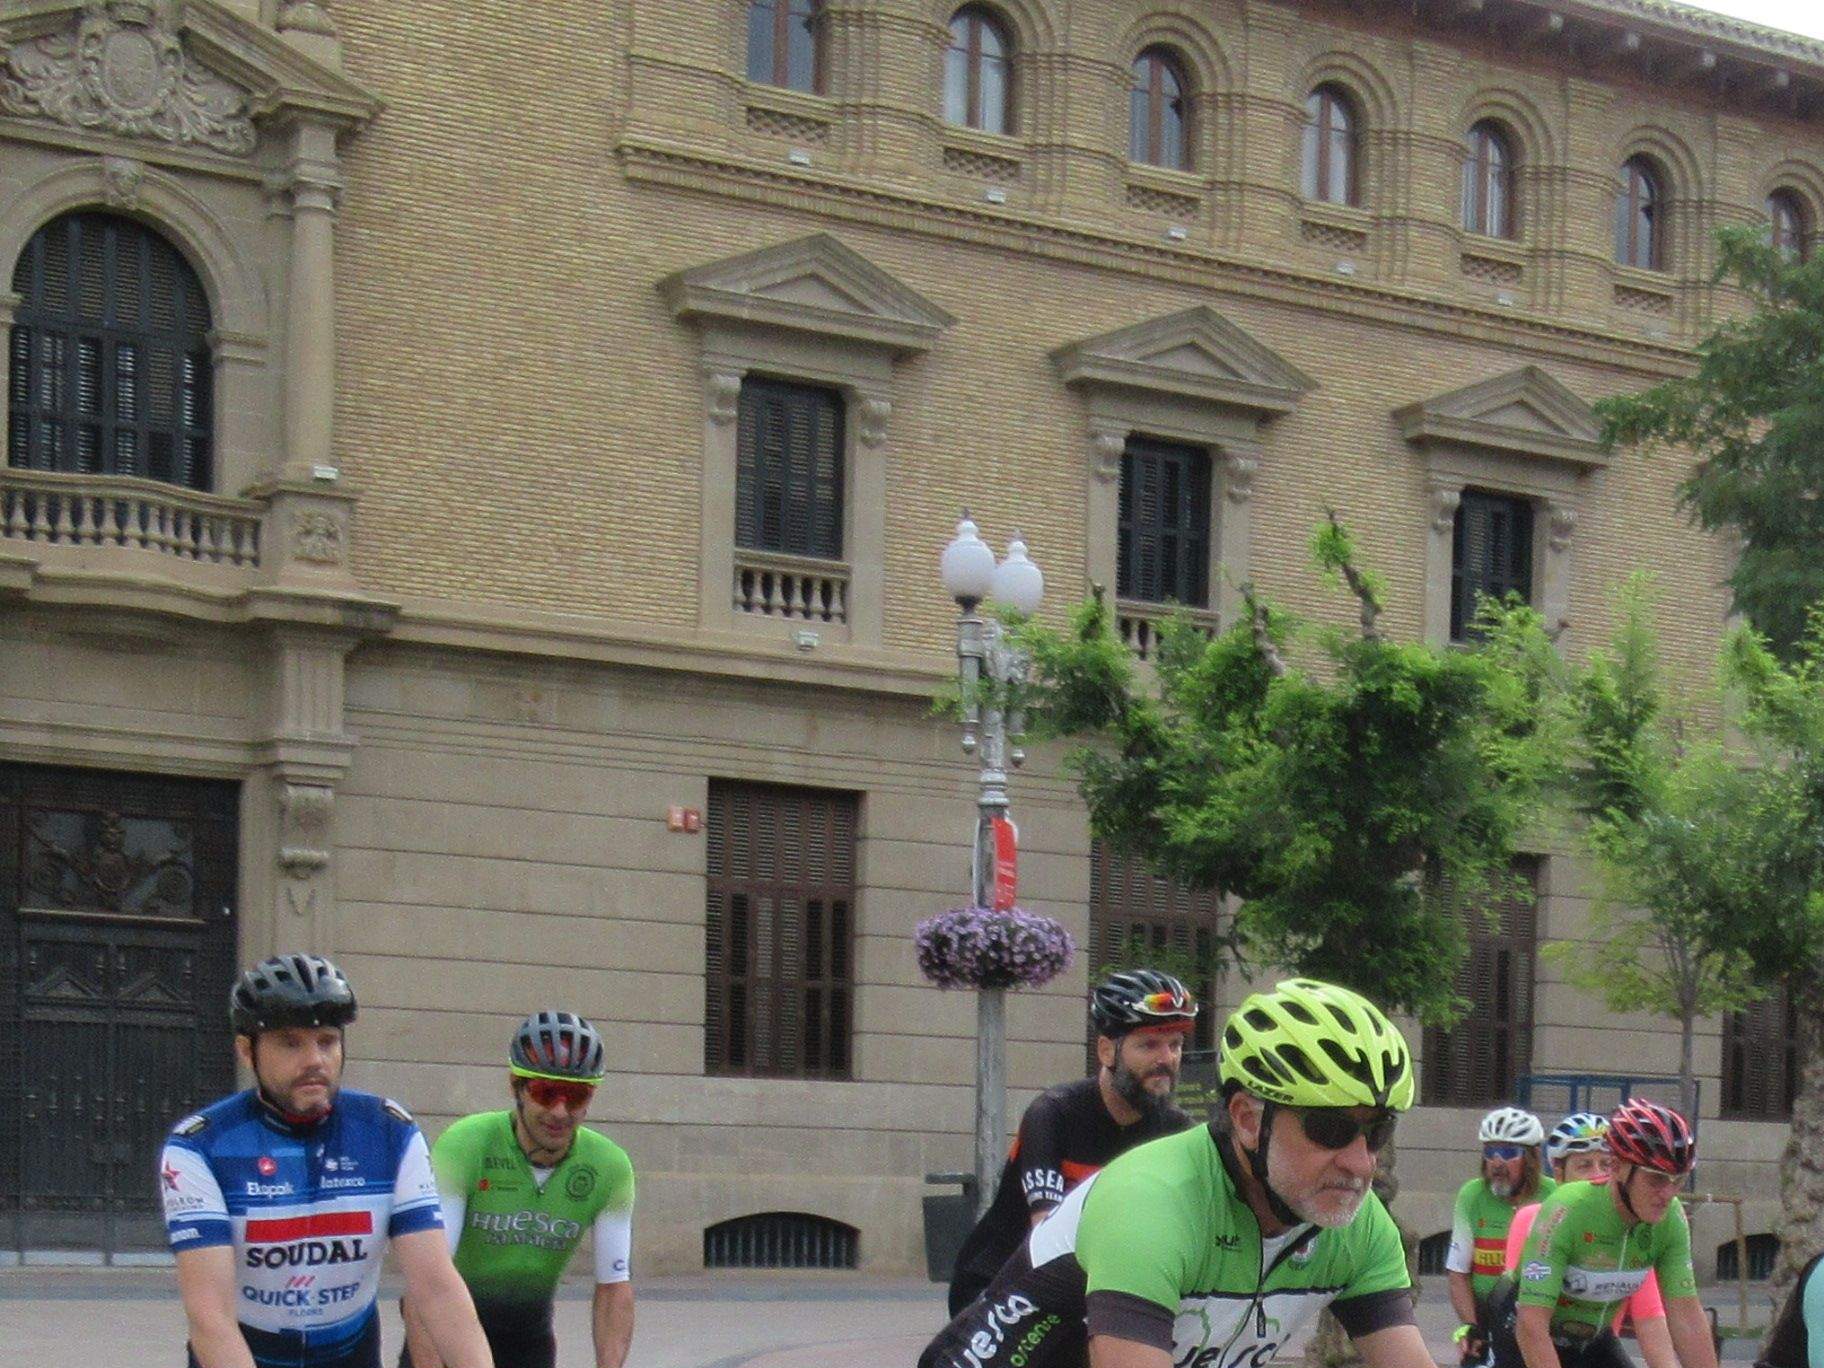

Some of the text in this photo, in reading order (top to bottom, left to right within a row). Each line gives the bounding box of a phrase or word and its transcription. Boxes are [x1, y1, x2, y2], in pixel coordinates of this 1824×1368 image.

[245, 1239, 368, 1269] SOUDAL
[242, 1281, 360, 1306] QUICK STEP
